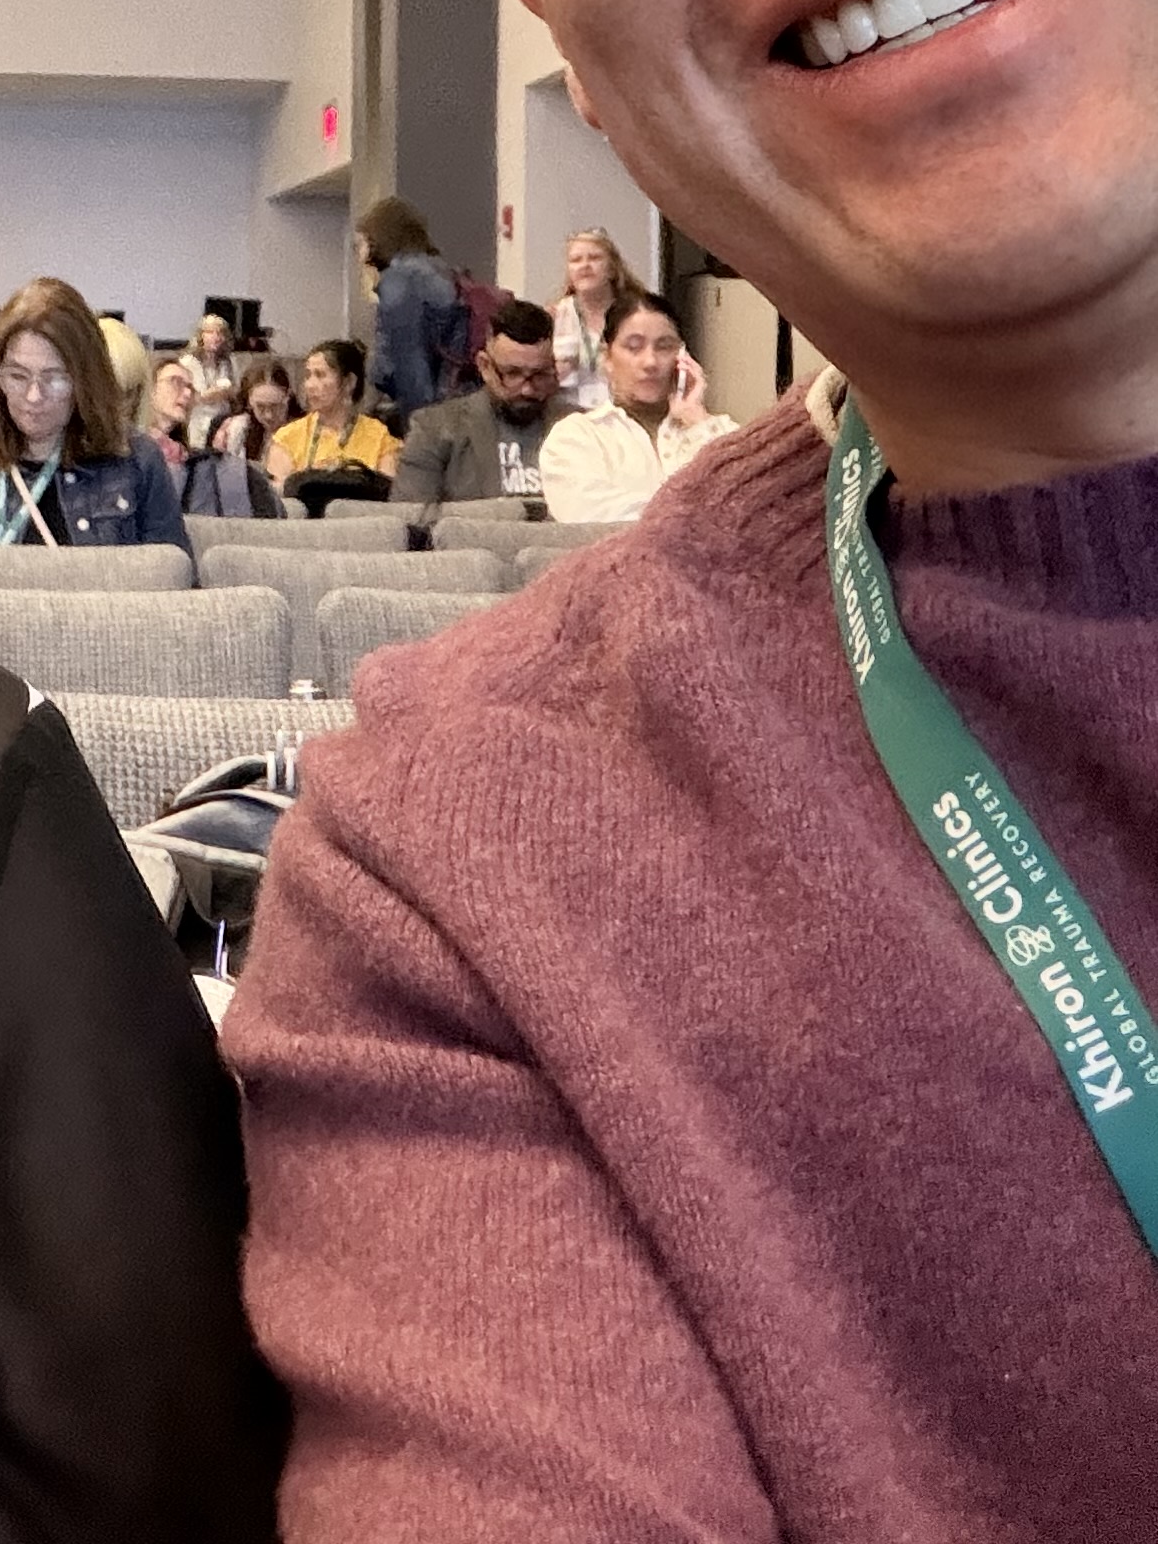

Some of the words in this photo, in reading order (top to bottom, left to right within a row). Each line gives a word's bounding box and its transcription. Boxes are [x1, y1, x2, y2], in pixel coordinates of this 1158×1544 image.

[843, 569, 876, 685] Khiron
[933, 791, 1023, 924] Clinics
[964, 772, 1048, 883] RECOVERY
[1045, 887, 1107, 983] TRAUMA
[1040, 961, 1134, 1113] Khiron
[1103, 988, 1158, 1085] GLOBAL
